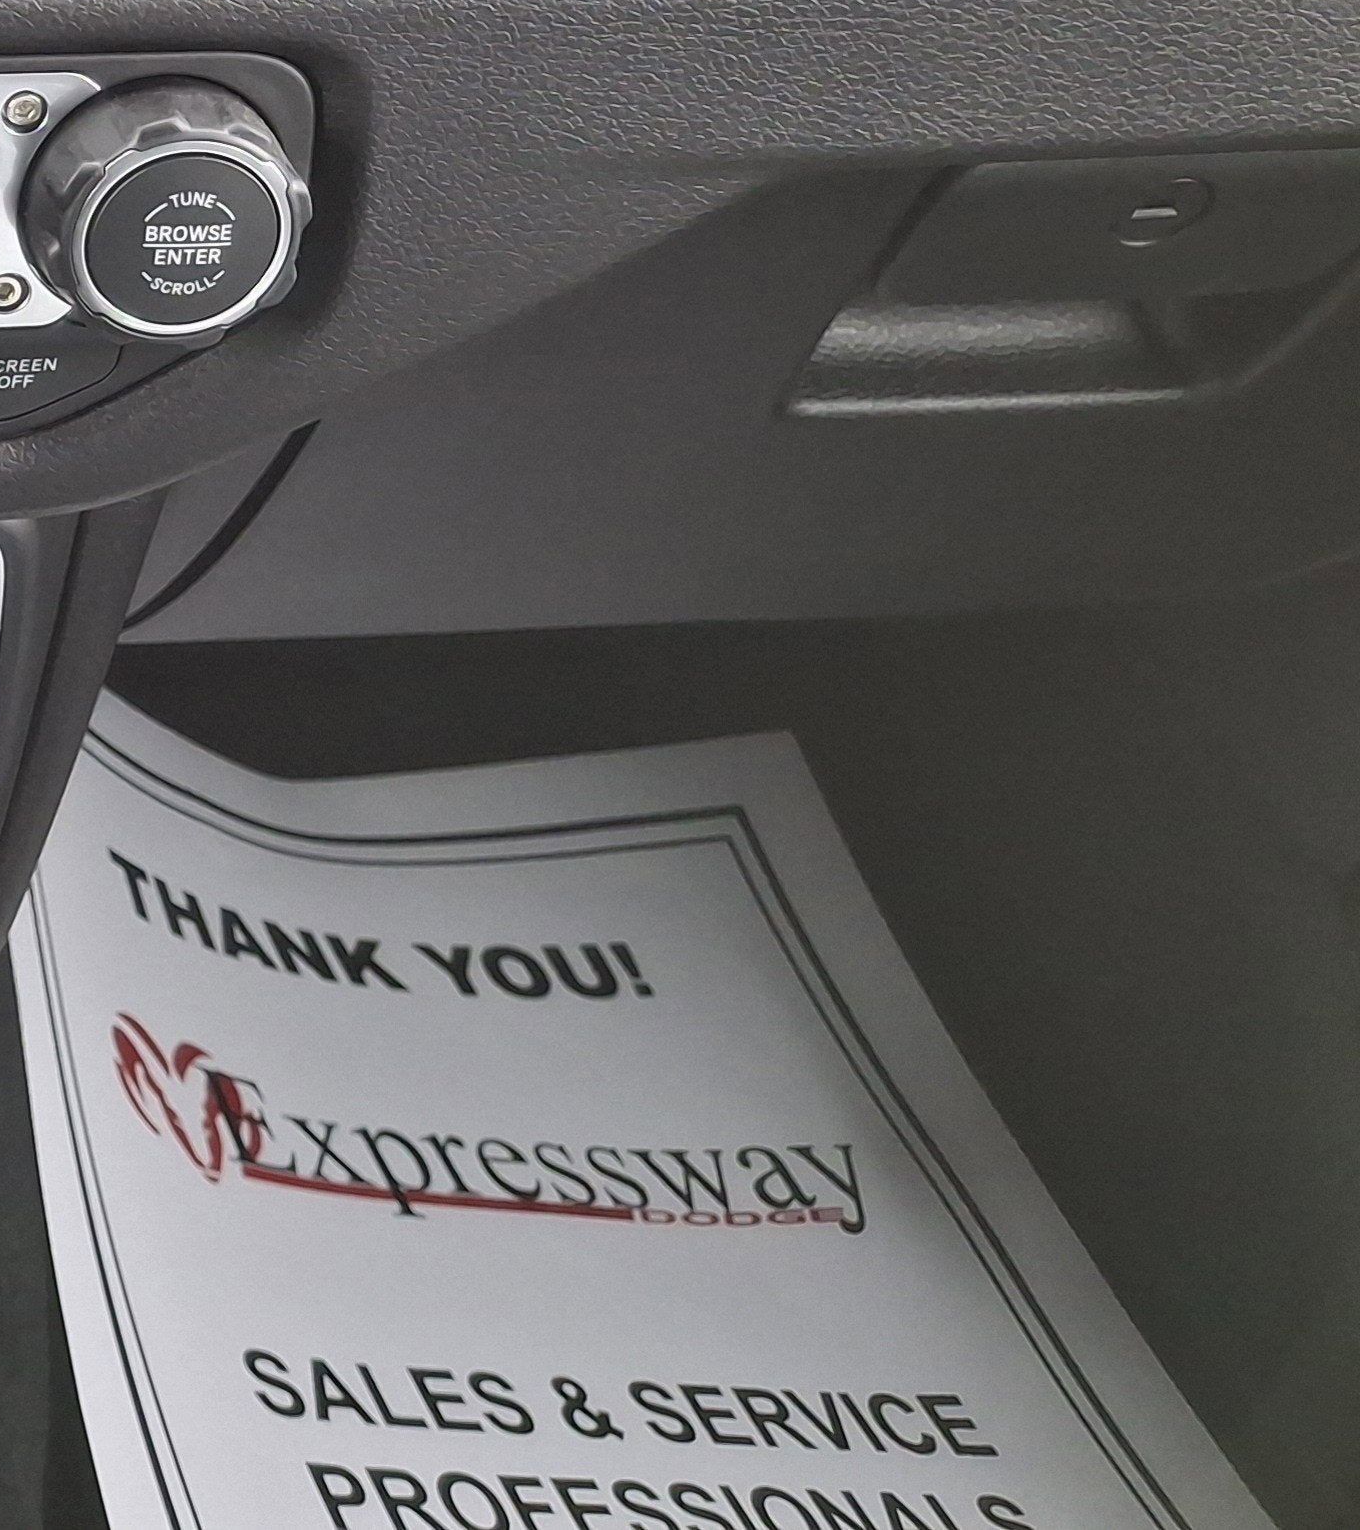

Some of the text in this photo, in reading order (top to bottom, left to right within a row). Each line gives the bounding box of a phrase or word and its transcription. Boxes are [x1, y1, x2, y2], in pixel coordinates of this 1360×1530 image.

[168, 193, 217, 209] TUNE
[144, 223, 232, 243] BROWSE
[153, 247, 222, 266] ENTER
[149, 274, 217, 297] SCROLL
[109, 848, 655, 1001] THANK YOU!
[196, 1065, 866, 1234] Expressway
[244, 1349, 998, 1459] SALES & SERVICE
